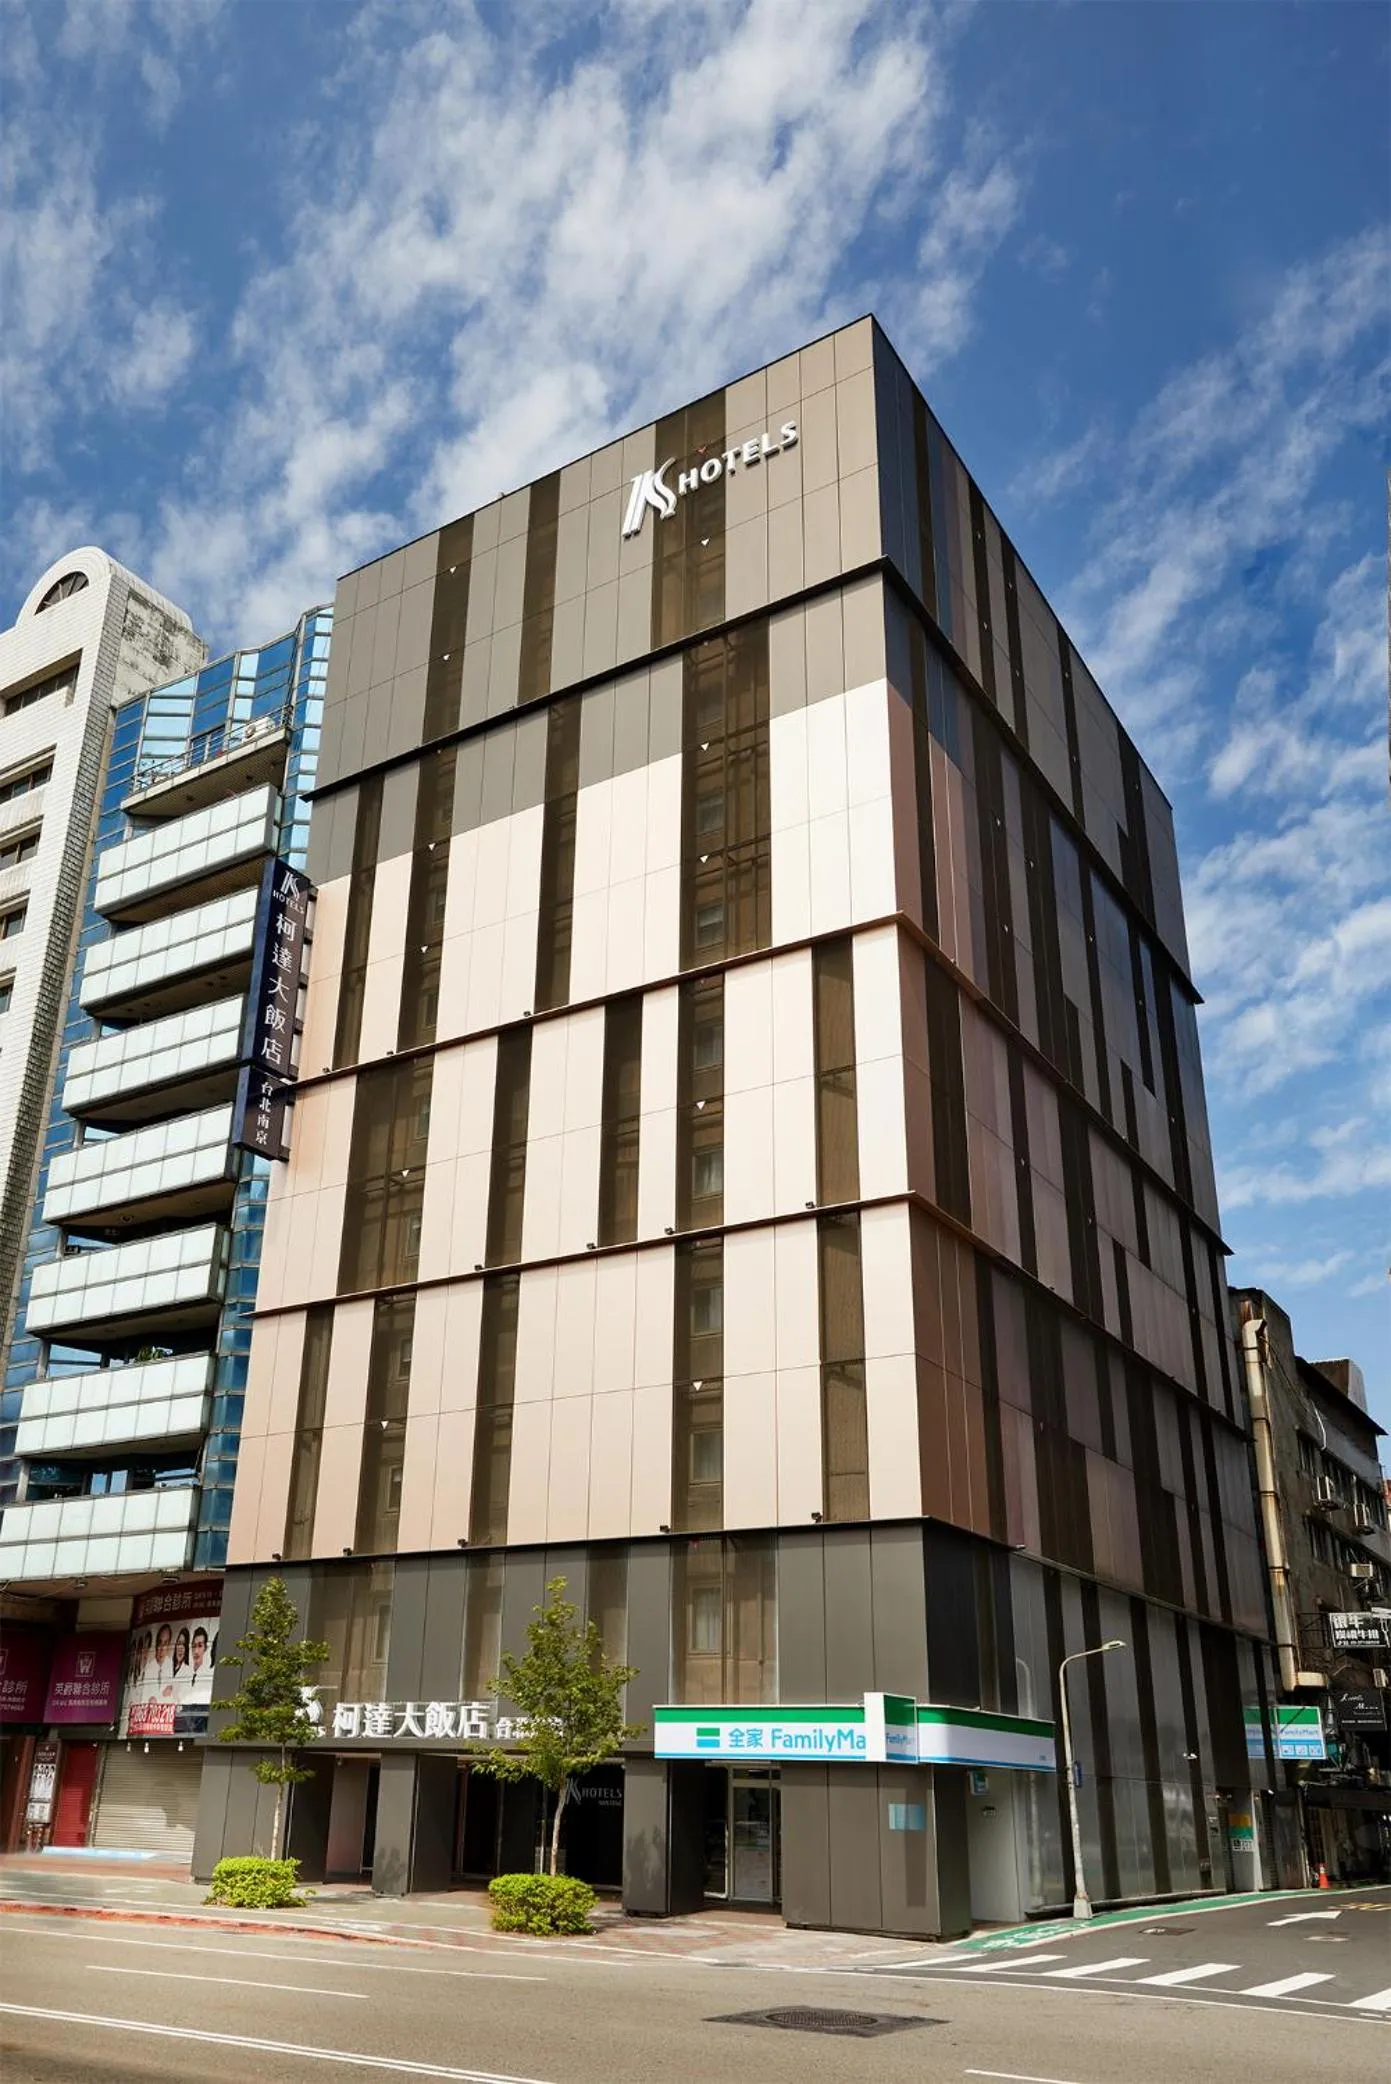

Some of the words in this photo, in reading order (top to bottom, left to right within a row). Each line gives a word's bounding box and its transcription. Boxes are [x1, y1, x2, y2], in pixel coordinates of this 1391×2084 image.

[678, 420, 800, 496] HOTELS
[273, 889, 305, 914] HOTELS
[260, 912, 298, 1067] 柯達大飯店
[255, 1081, 274, 1146] 台北南京
[0, 1679, 28, 1696] 診所
[332, 1702, 493, 1739] 柯達大飯店
[728, 1727, 764, 1748] 全家
[581, 1787, 622, 1799] HOTELS
